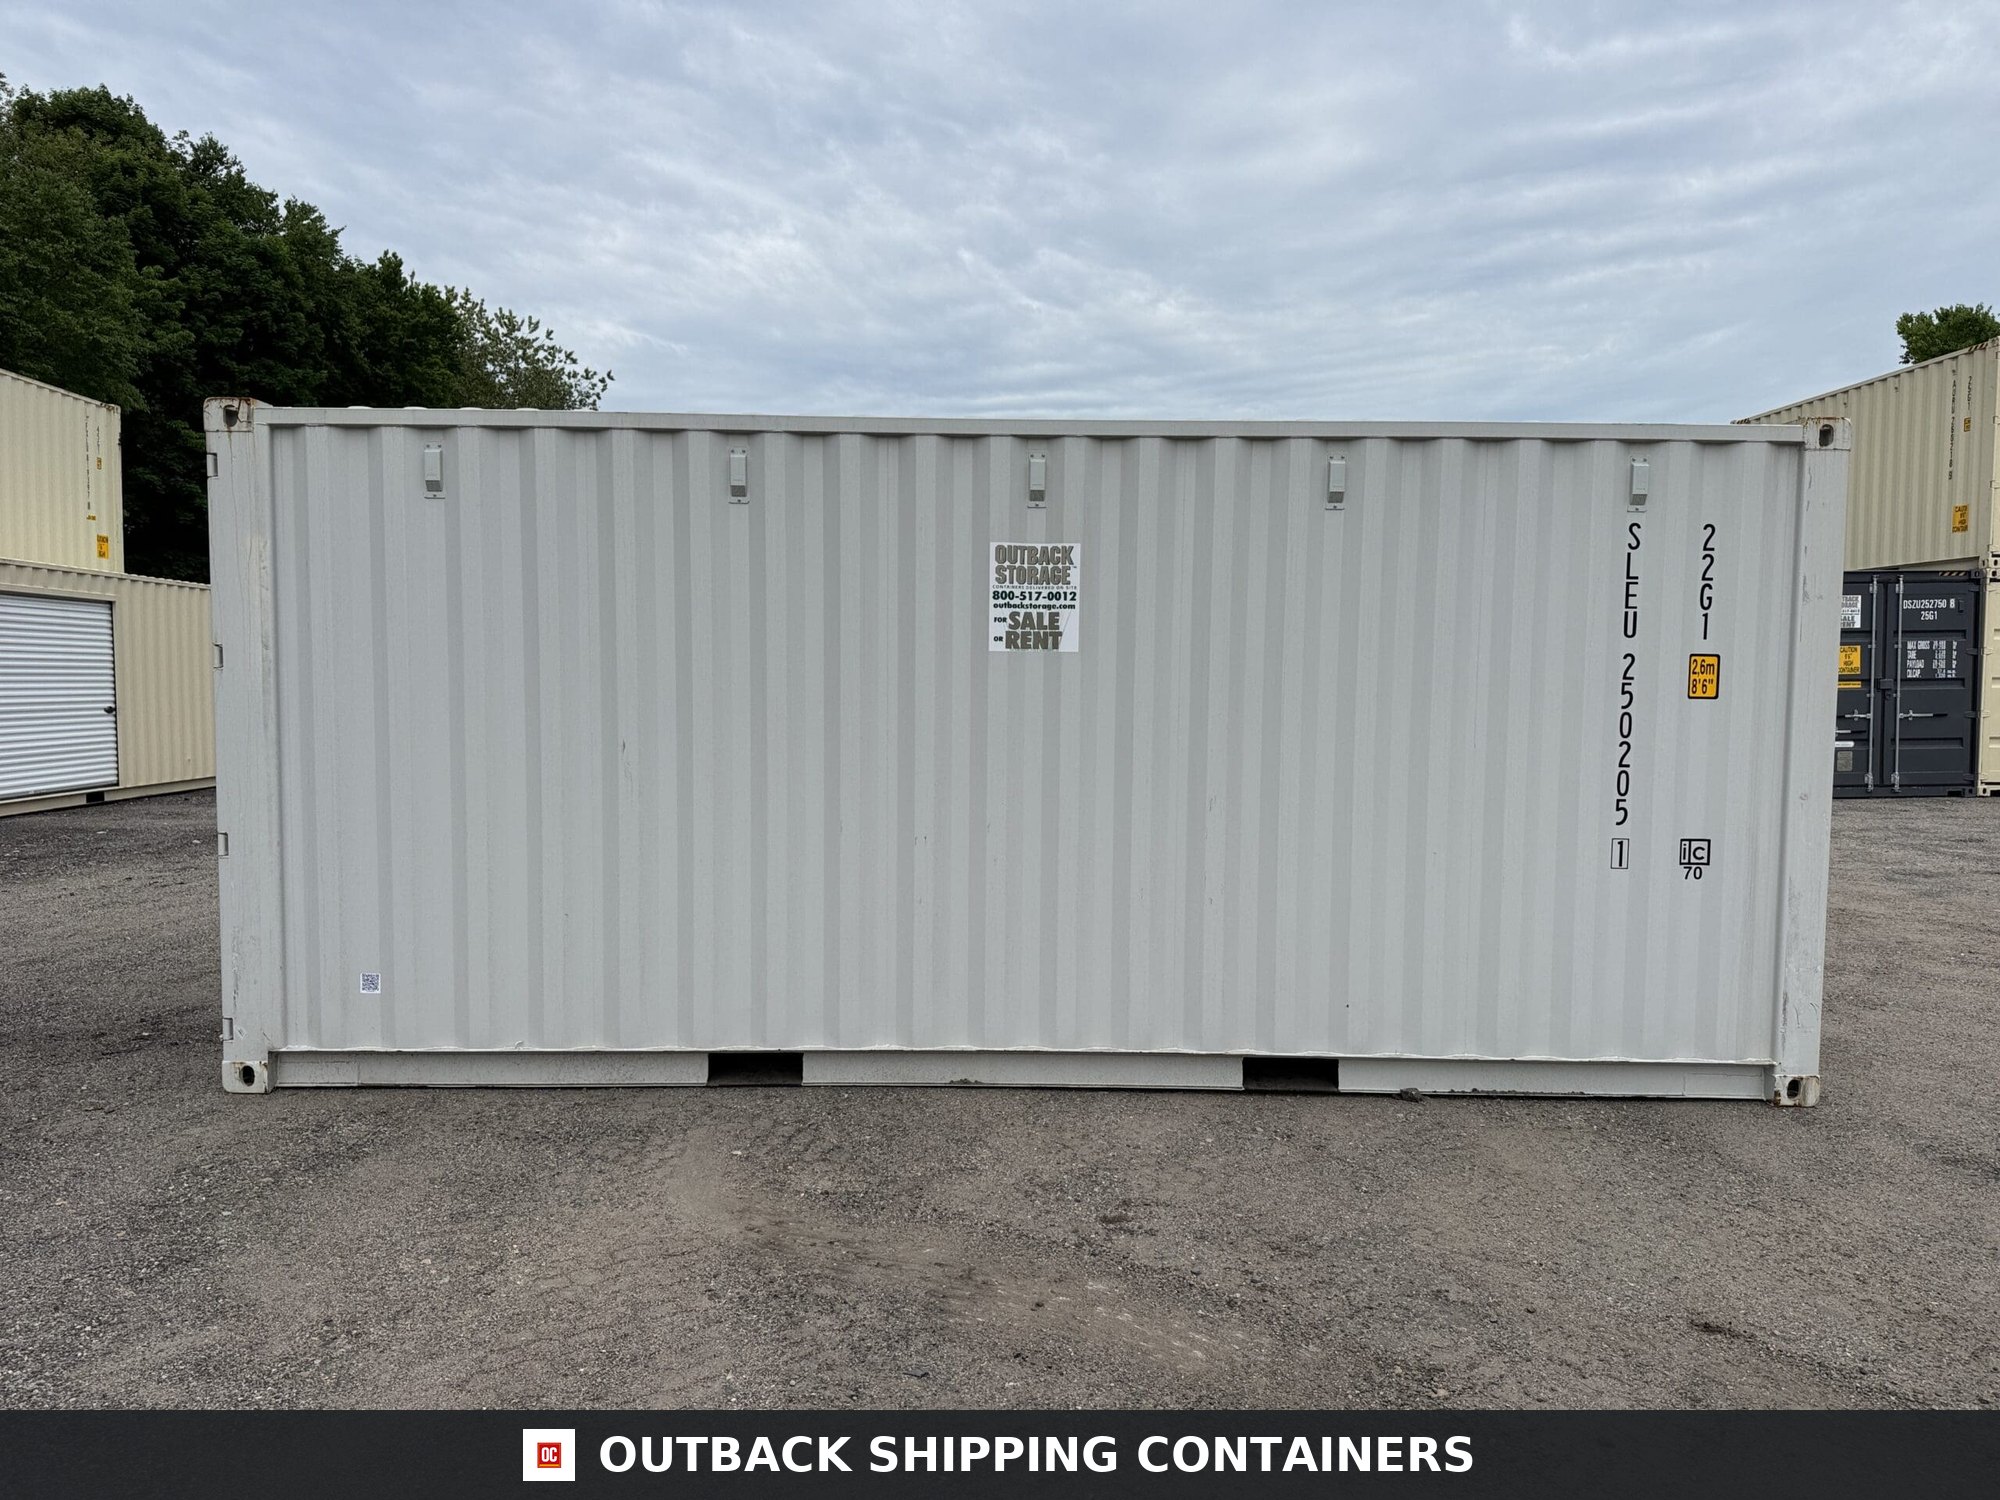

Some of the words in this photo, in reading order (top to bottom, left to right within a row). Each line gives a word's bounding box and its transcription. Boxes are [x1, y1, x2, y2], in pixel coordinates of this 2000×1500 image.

[995, 544, 1074, 565] OUTBACK
[995, 565, 1071, 585] STORAGE
[1623, 522, 1641, 639] SLEU
[1700, 523, 1716, 640] 22G1
[992, 590, 1077, 601] 800-517-0012
[1949, 598, 1956, 609] 8
[993, 601, 1076, 610] outbackstorage.com
[1008, 611, 1060, 630] SALE
[1920, 611, 1938, 620] 25G1
[1005, 630, 1063, 650] RENT
[1691, 658, 1715, 677] 2,6m
[1691, 678, 1714, 694] 8'6"
[1615, 653, 1636, 826] 250205
[1683, 866, 1703, 880] 70
